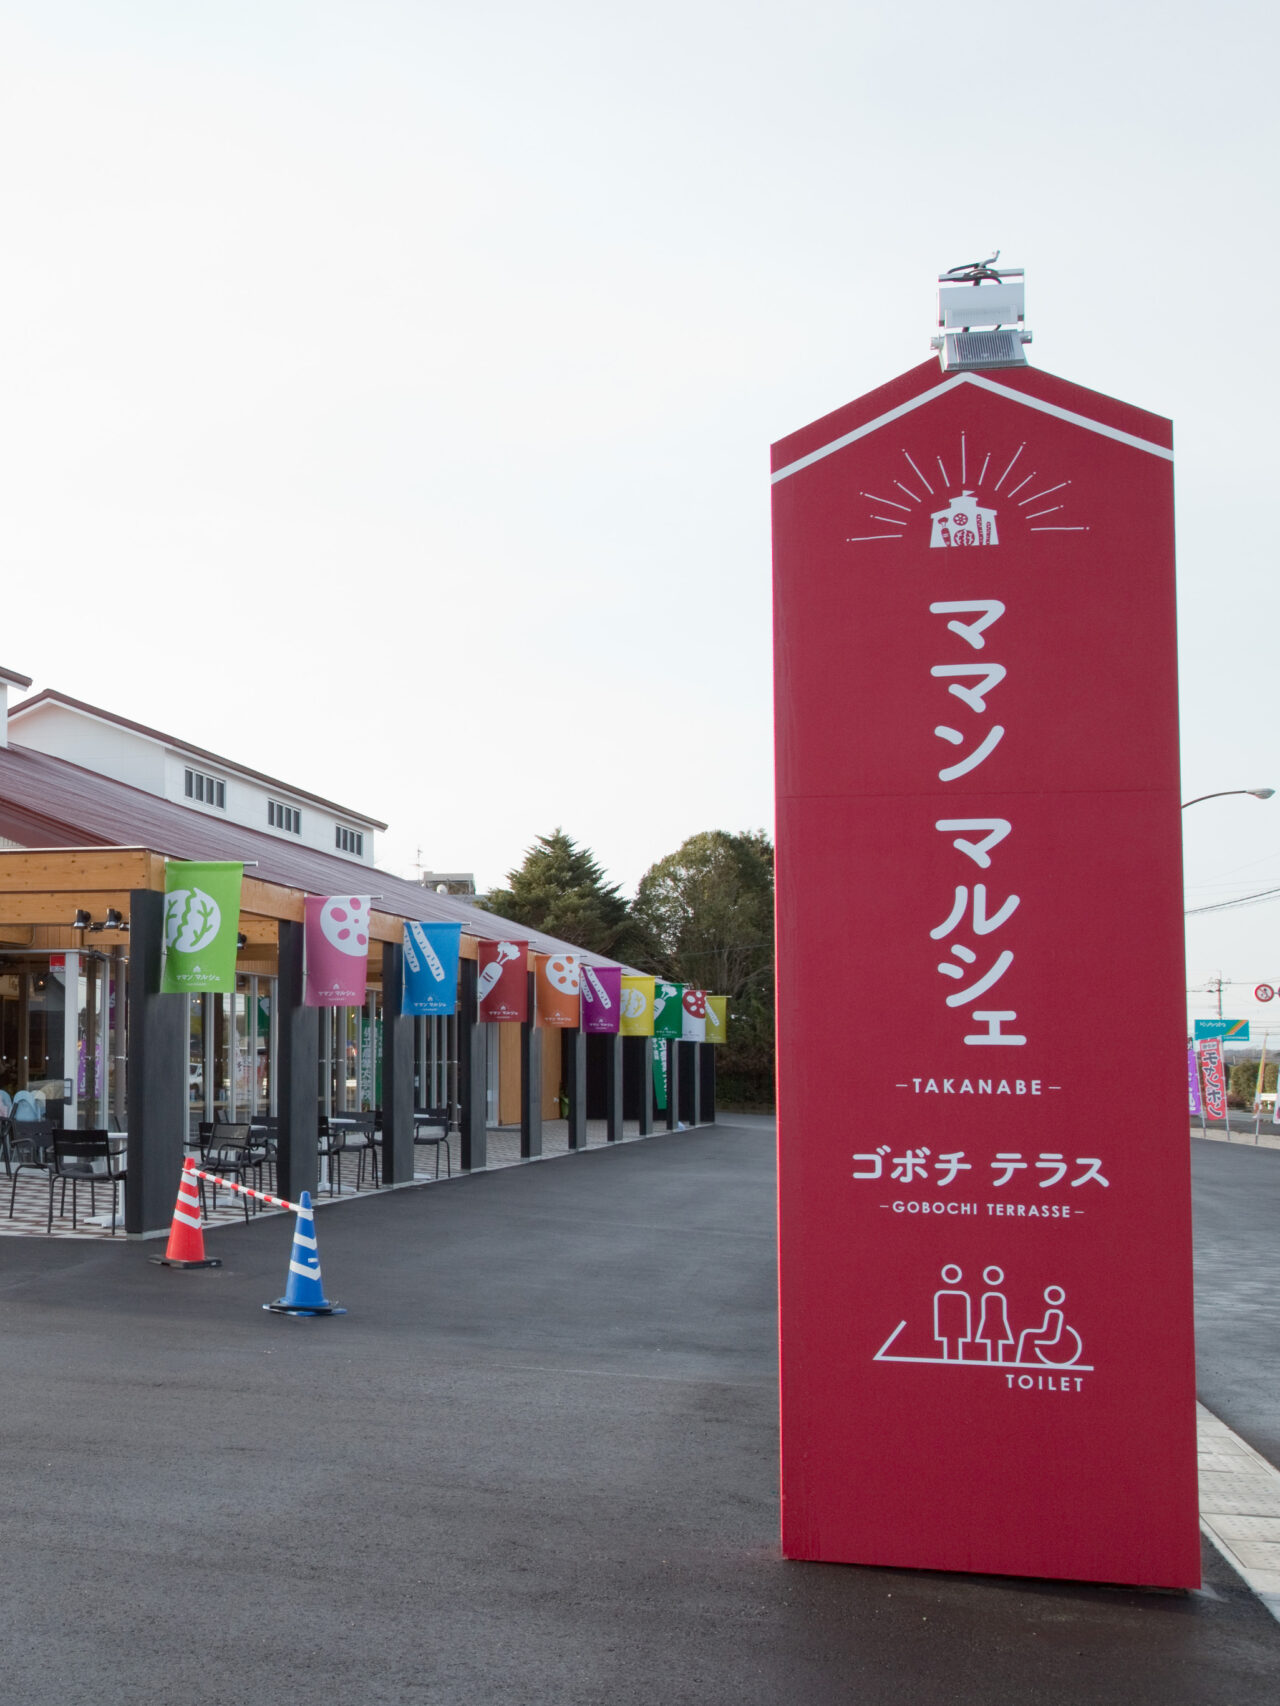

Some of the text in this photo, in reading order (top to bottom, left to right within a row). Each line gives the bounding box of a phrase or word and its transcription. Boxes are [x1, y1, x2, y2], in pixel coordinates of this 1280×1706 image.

[929, 600, 1027, 1046] ママン マルシェ
[913, 1078, 1042, 1096] TAKANABE
[852, 1144, 1110, 1188] ゴボチ テラス
[892, 1200, 1071, 1219] GOBOCHI TERRASSE
[1005, 1374, 1084, 1392] TOILET
